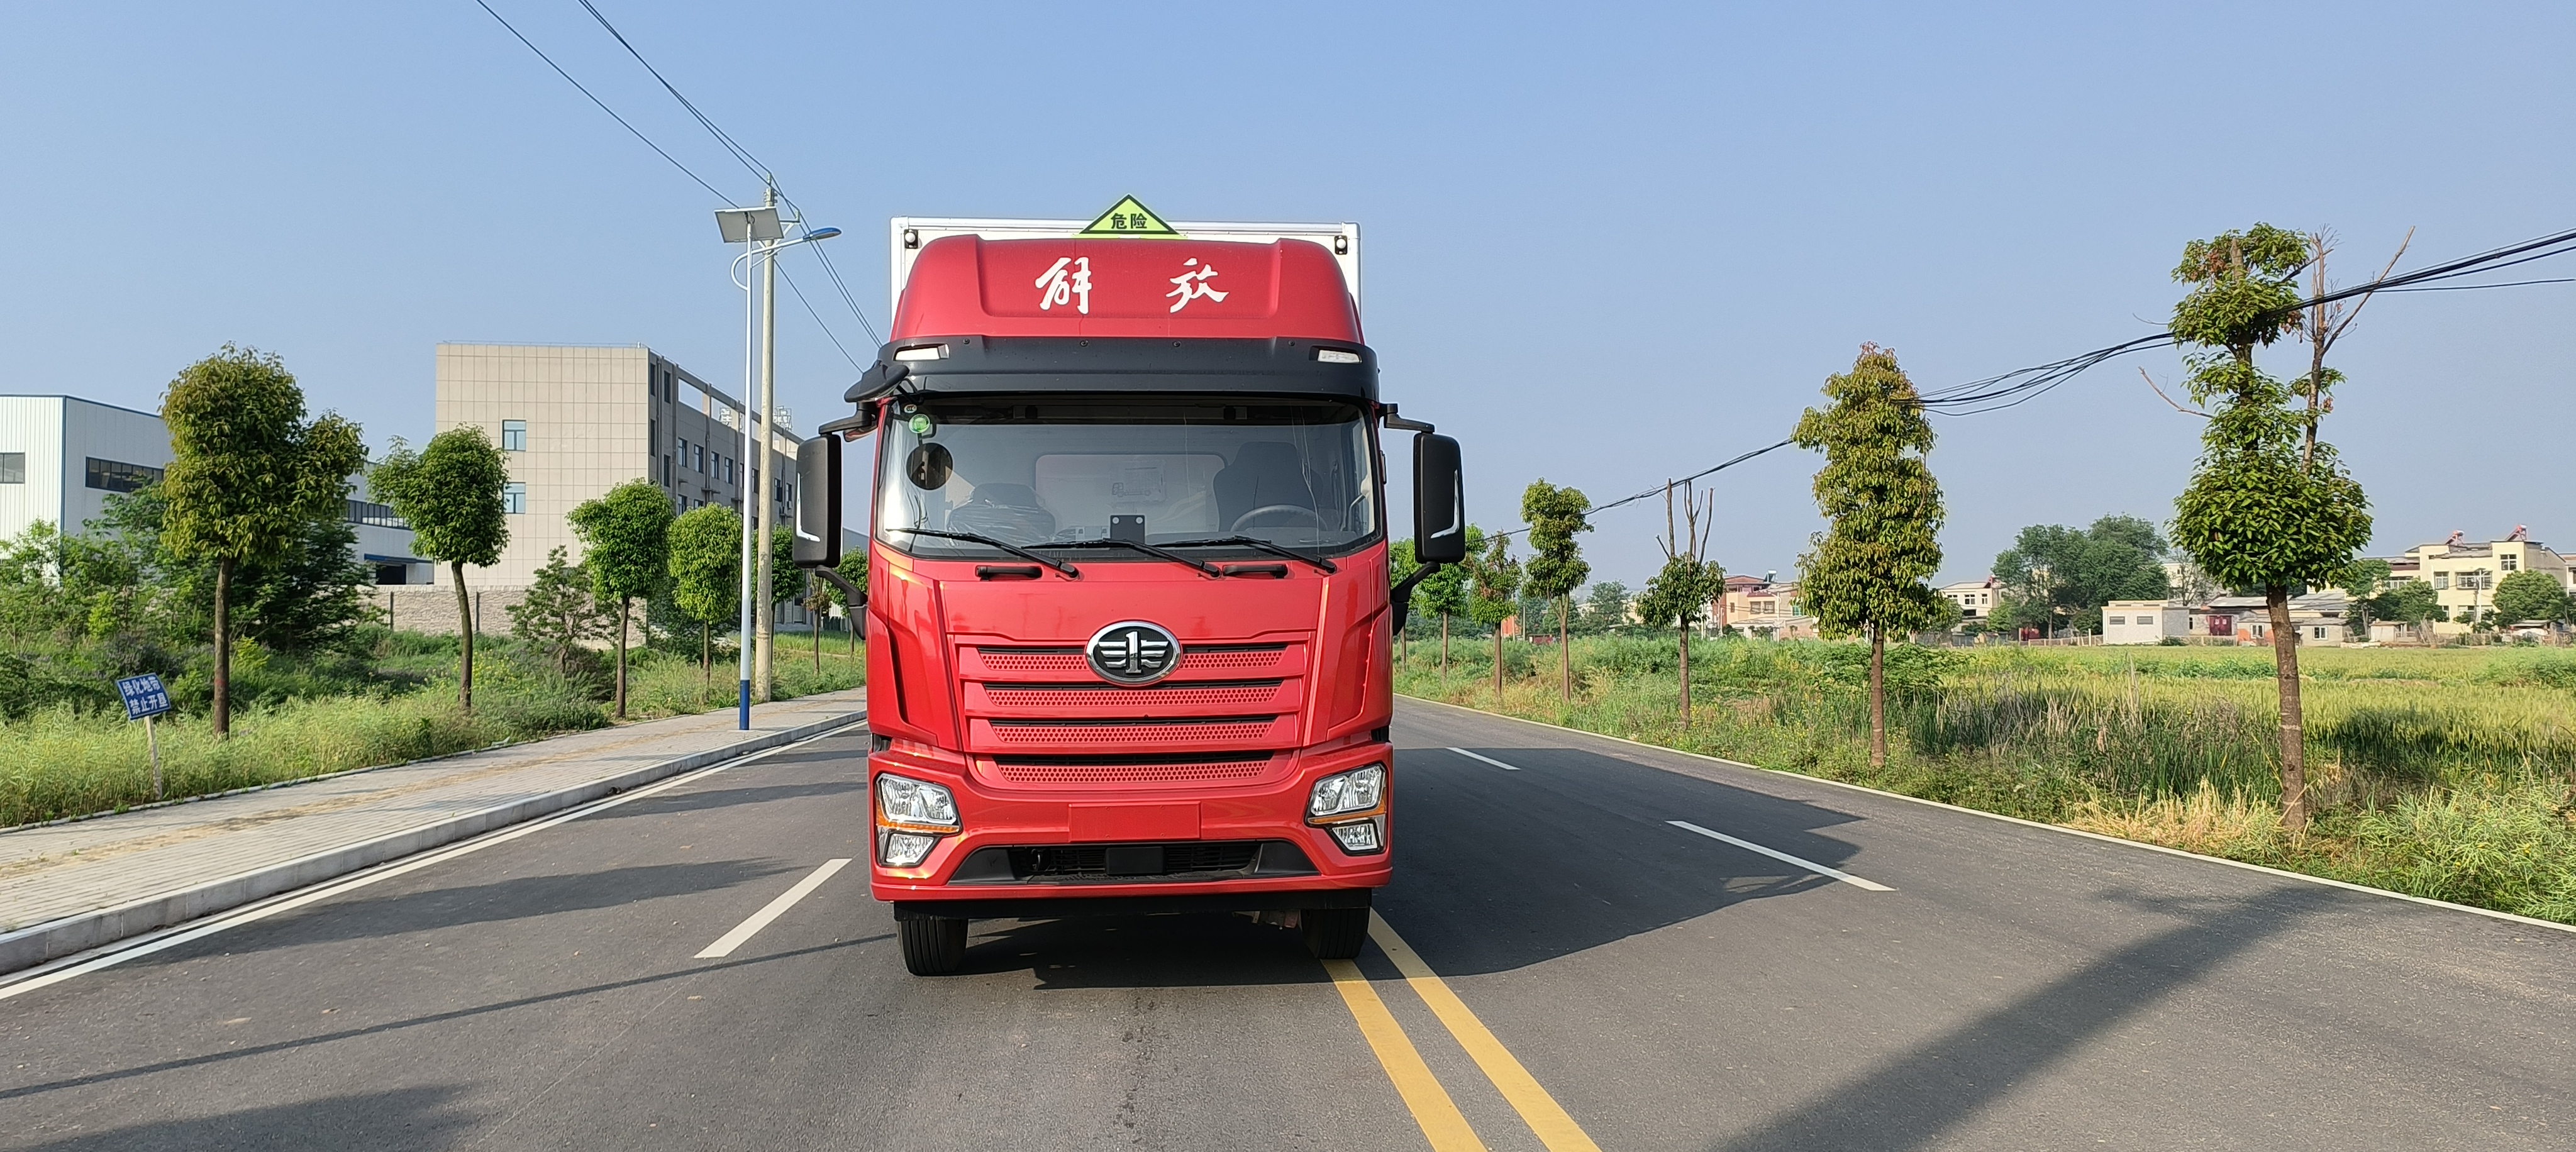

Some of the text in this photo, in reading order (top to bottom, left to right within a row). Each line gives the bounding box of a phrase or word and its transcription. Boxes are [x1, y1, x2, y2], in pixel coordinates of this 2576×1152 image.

[1110, 213, 1148, 229] 危险
[1035, 257, 1230, 314] 解放
[122, 676, 160, 697] 绿化地带
[129, 692, 168, 715] 禁止开垦
